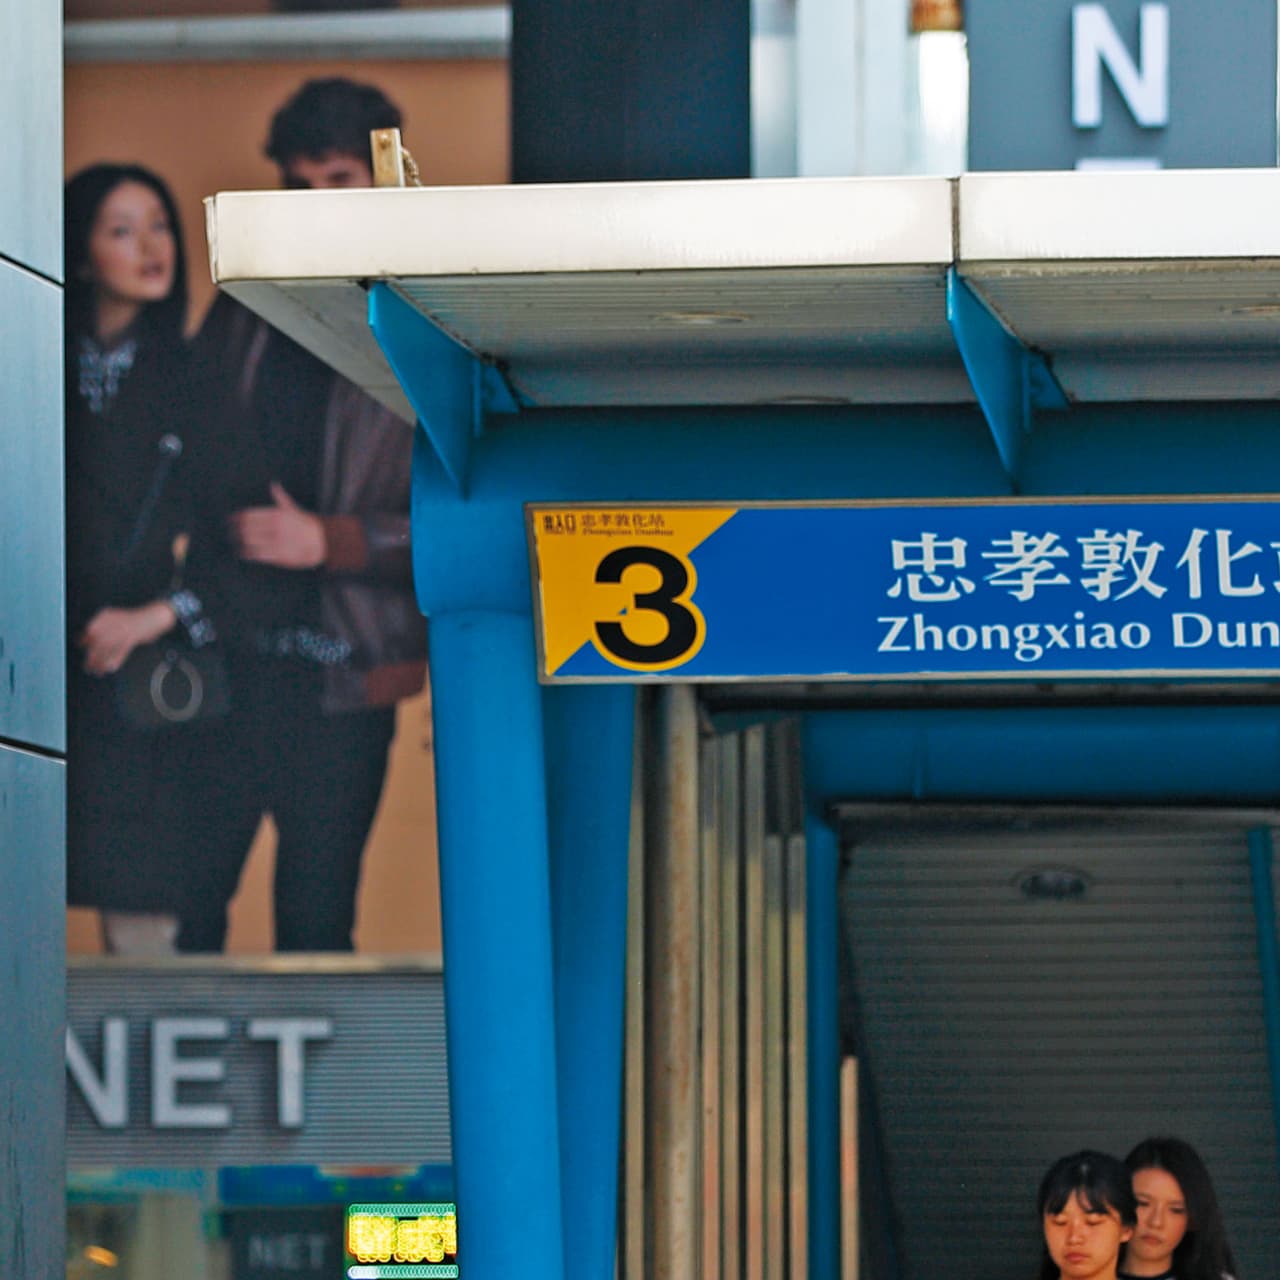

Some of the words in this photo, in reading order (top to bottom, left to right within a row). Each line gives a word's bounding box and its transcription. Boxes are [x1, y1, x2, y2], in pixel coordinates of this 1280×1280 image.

[1072, 3, 1169, 168] N
[594, 545, 698, 664] 3
[876, 611, 1152, 662] Zhongxiao
[65, 1017, 333, 1128] NET
